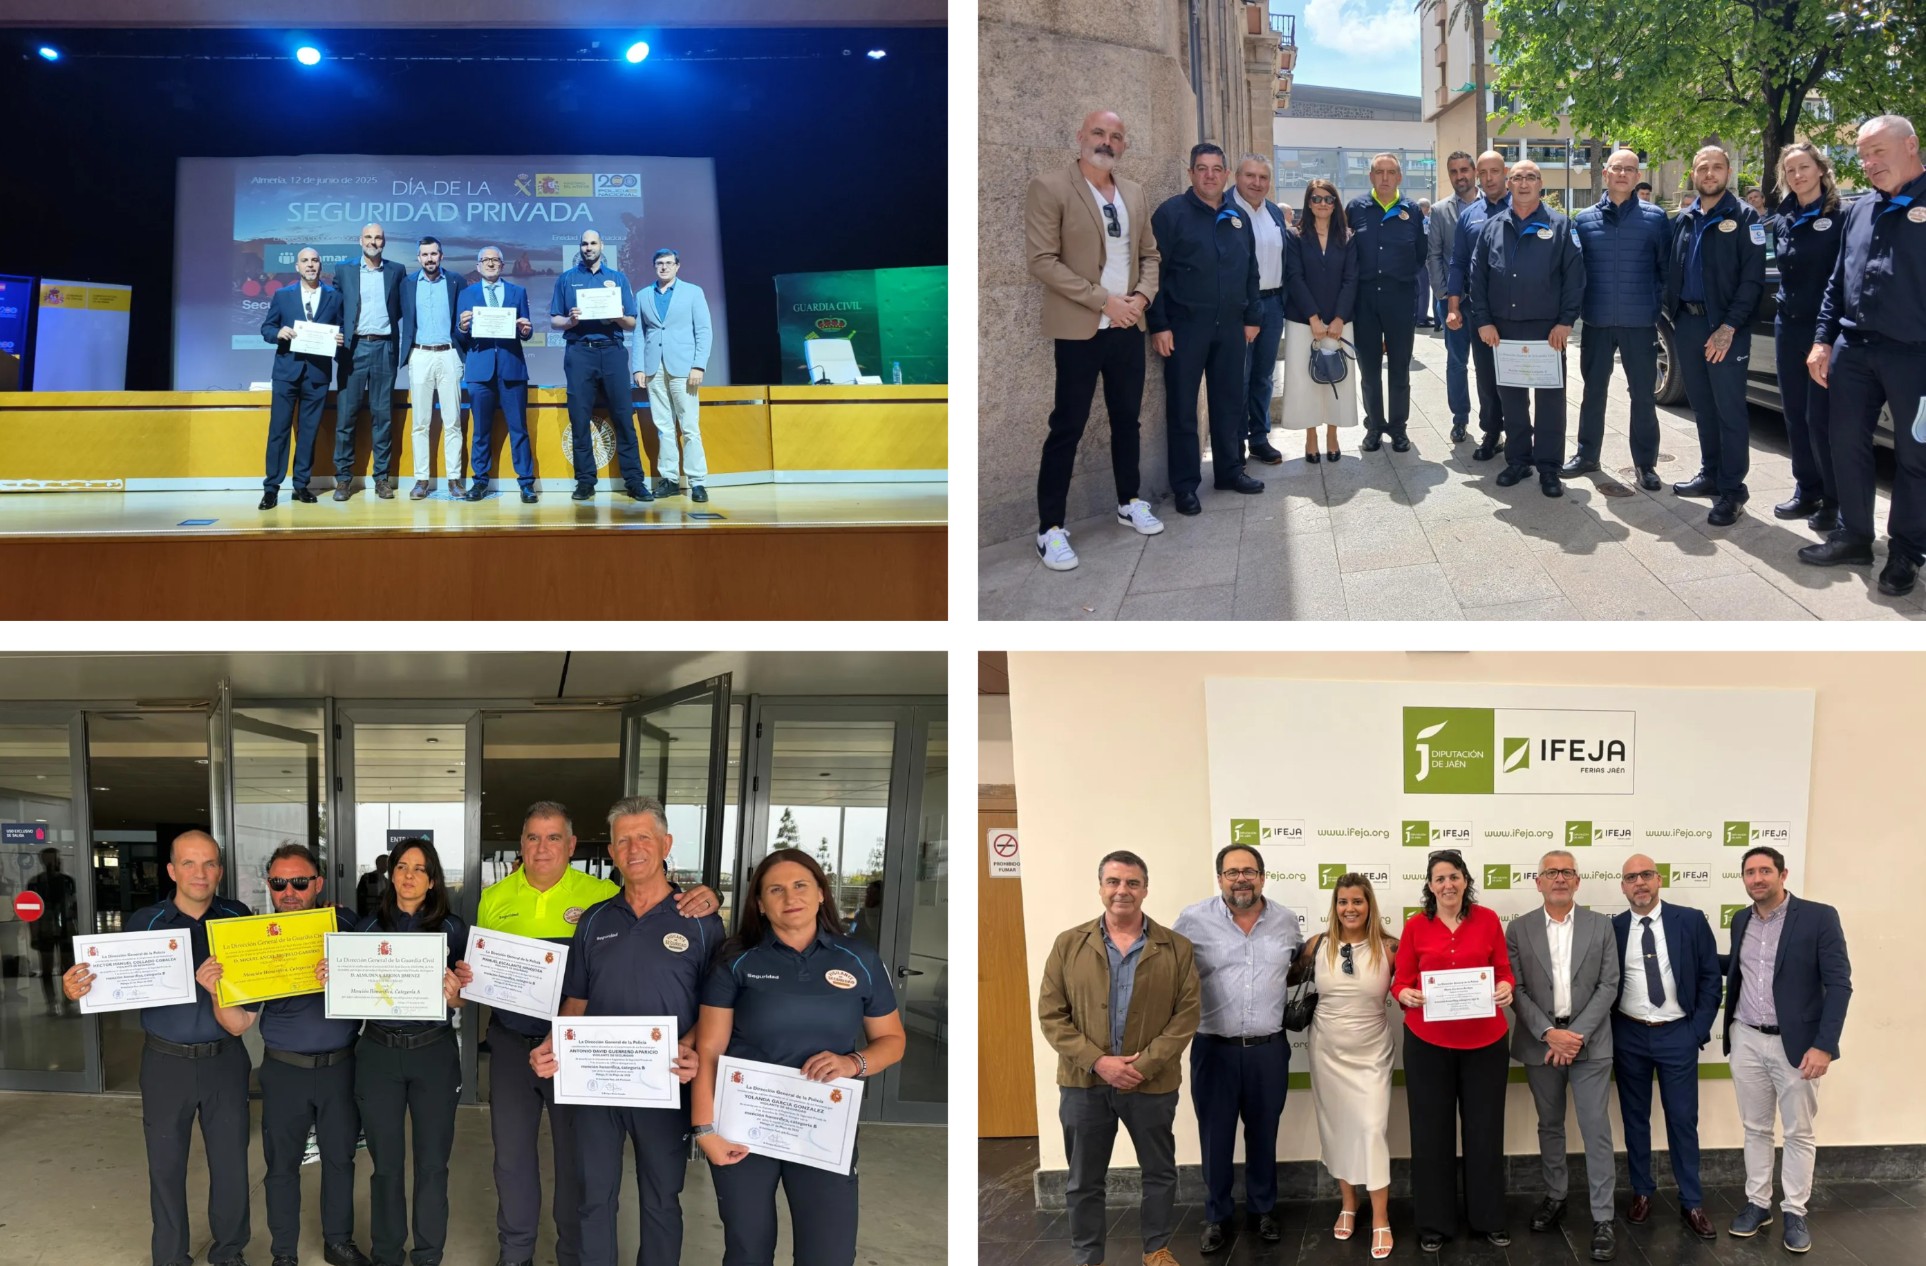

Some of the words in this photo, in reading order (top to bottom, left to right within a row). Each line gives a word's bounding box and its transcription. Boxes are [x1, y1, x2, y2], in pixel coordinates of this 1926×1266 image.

[251, 176, 287, 186] Almería,
[291, 176, 301, 184] 12
[303, 176, 315, 184] de
[316, 176, 340, 186] junio
[341, 176, 353, 184] de
[355, 176, 378, 184] 2025
[392, 177, 427, 196] DÍA
[434, 180, 461, 196] DE
[467, 180, 492, 196] LA
[287, 202, 459, 222] SEGURIDAD
[467, 202, 594, 222] PRIVADA
[793, 302, 836, 312] GUARDIA
[836, 301, 862, 311] CIVIL
[1431, 749, 1484, 758] DIPUTACIÓN
[1540, 738, 1626, 762] IFEJA
[1431, 760, 1444, 768] DE
[1444, 759, 1466, 768] JAÉN
[1274, 828, 1302, 836] IFEJA
[1317, 828, 1390, 839] www.ifeja.org
[1484, 828, 1554, 839] www.ifeja.org
[1645, 829, 1713, 839] www.ifeja.org
[1266, 871, 1306, 882] feja.org
[1682, 871, 1708, 880] IFEJA
[596, 932, 618, 941] Seguridad
[753, 1086, 775, 1094] Dirección
[776, 1090, 795, 1098] General
[745, 1094, 771, 1103] YOLANDA
[771, 1099, 793, 1107] GARCIA
[794, 1104, 825, 1114] GONZALEZ
